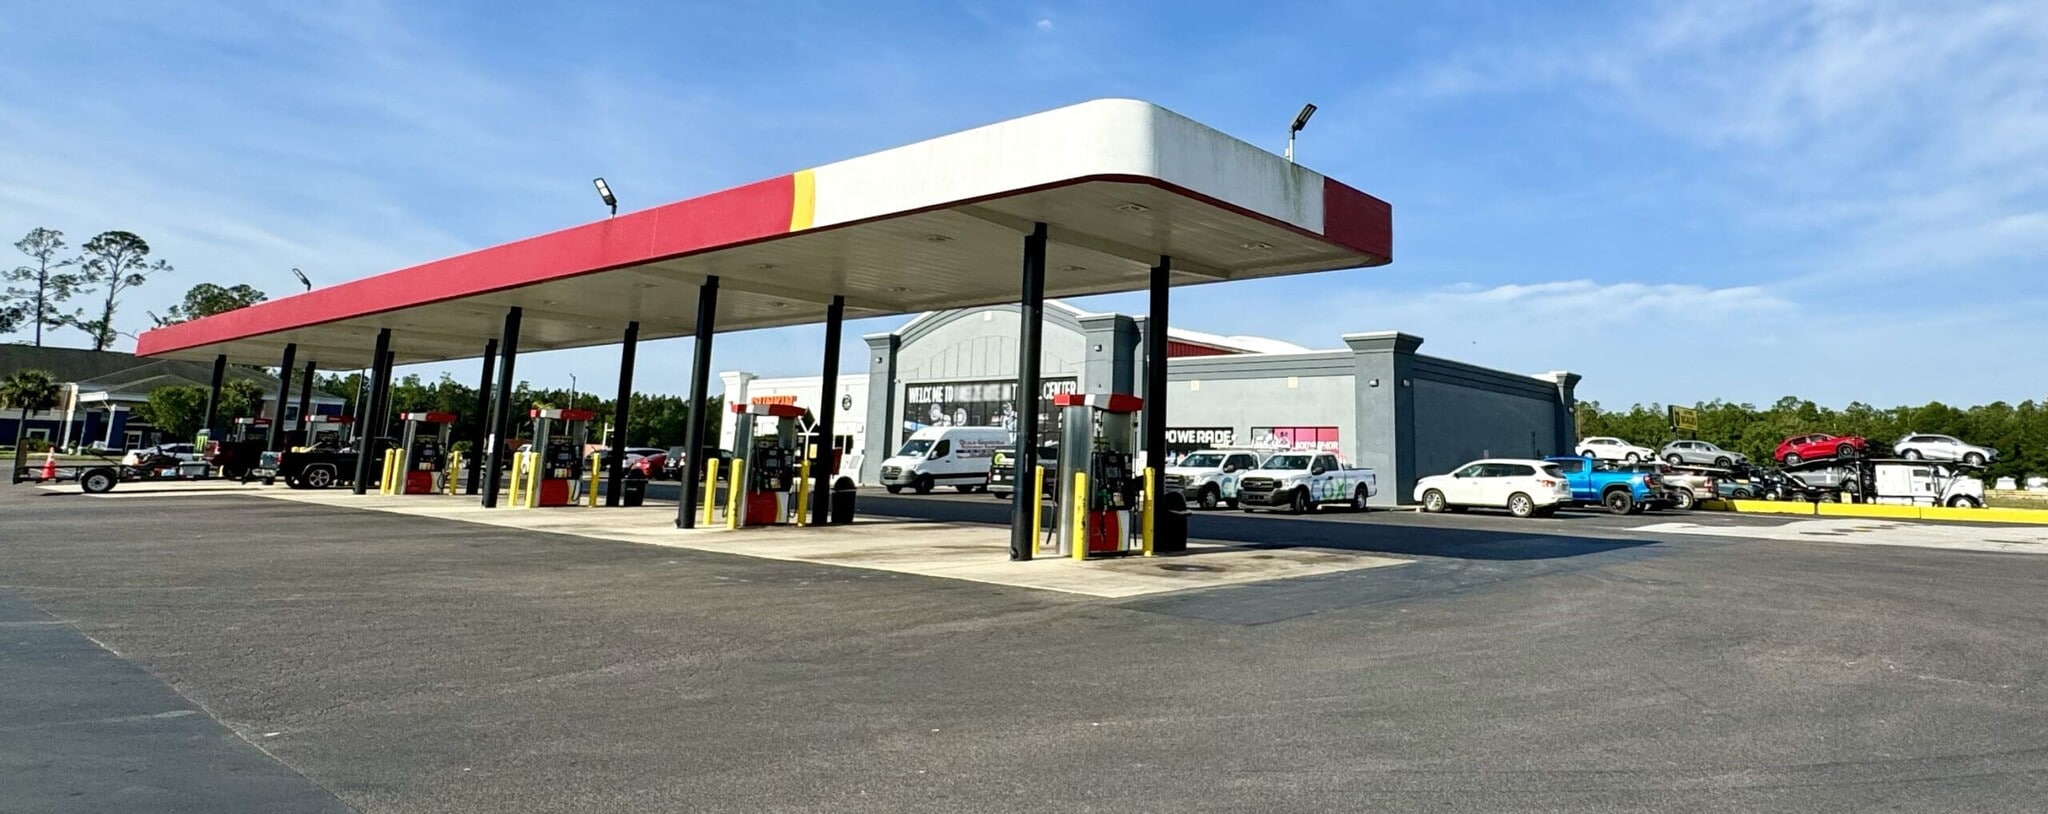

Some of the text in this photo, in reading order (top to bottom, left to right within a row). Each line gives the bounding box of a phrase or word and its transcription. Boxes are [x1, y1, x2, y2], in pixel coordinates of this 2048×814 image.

[908, 386, 943, 403] WELCOME
[944, 385, 954, 402] TO
[1043, 381, 1077, 400] CENTER
